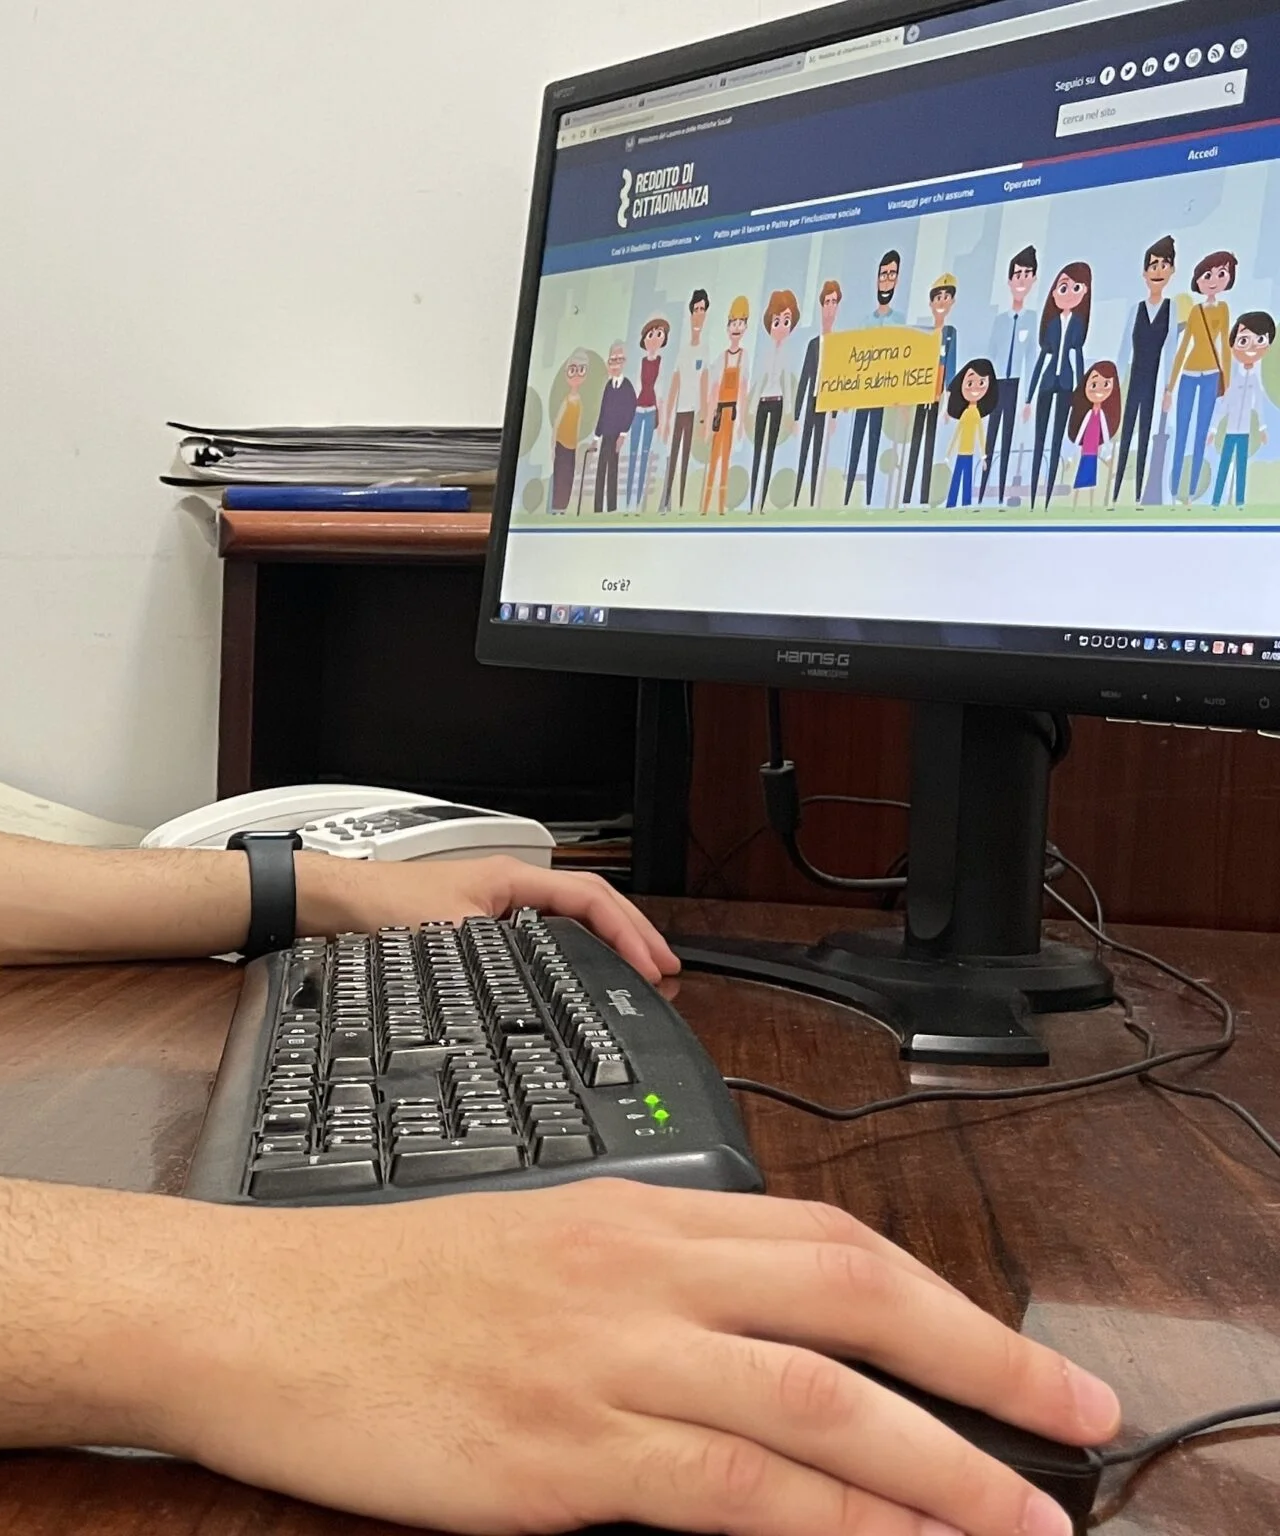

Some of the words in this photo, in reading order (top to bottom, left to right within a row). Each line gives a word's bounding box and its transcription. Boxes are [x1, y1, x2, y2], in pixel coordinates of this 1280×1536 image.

[1055, 75, 1084, 92] Seguici
[1085, 75, 1096, 85] su
[1062, 113, 1084, 125] cerca
[1085, 109, 1099, 122] nel
[1100, 107, 1116, 119] sito
[1187, 146, 1219, 161] Accedi
[635, 165, 680, 193] REDDITO
[682, 162, 695, 184] DI
[1003, 176, 1042, 192] Operatori
[632, 184, 709, 219] CITTADINANZA
[887, 197, 919, 210] Vantaggi
[919, 196, 932, 207] per
[932, 193, 945, 203] chi
[945, 189, 974, 201] assume
[771, 220, 788, 229] Patto
[789, 217, 800, 228] per
[801, 211, 837, 224] l'inclusione
[838, 207, 861, 219] sociale
[848, 345, 899, 372] Aggiorna
[903, 345, 911, 359] o
[820, 375, 860, 393] richiedi
[864, 371, 898, 390] subito
[601, 578, 630, 592] Cos'è?
[1204, 697, 1226, 706] AUTO
